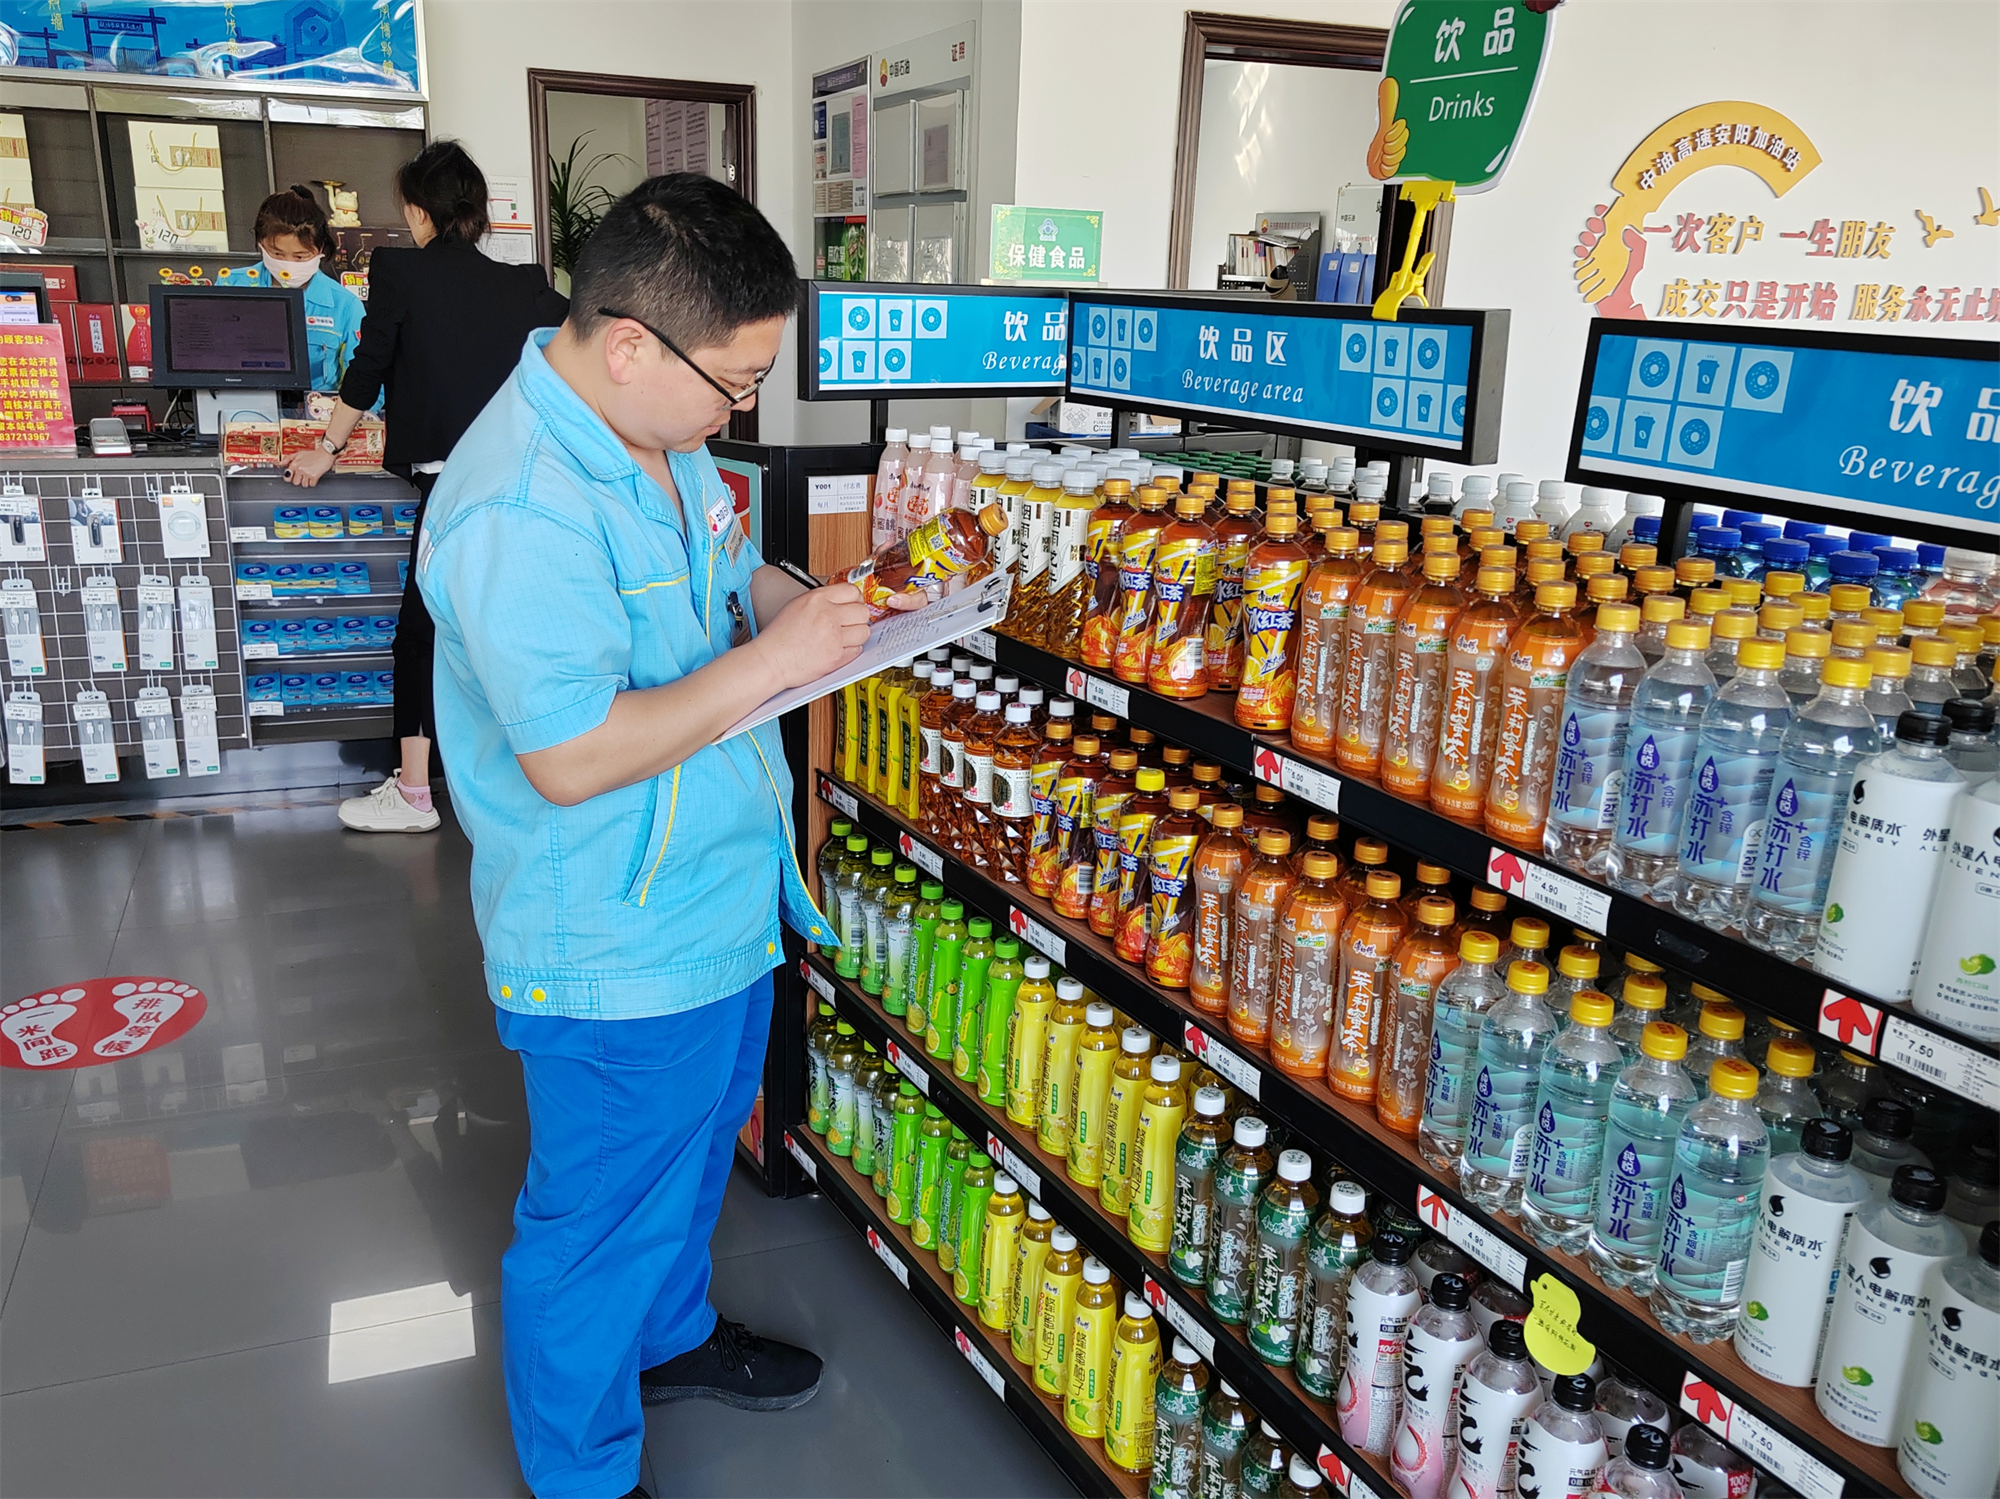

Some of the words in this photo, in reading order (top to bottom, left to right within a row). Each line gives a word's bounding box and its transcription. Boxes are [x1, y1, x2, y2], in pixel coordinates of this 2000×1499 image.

[1435, 7, 1516, 64] 饮品
[889, 58, 911, 78] 中国石油
[1428, 91, 1495, 122] Drinks
[1639, 123, 1802, 191] 中油高速安阳加油站
[11, 225, 32, 240] 120
[1644, 212, 1765, 255] 一次客户
[1780, 217, 1896, 259] 一生朋友
[1008, 242, 1086, 270] 保健食品
[1657, 278, 1838, 321] 成交只是开始
[0, 335, 49, 345] 顾客您好：
[1003, 310, 1066, 342] 饮品
[1199, 325, 1288, 367] 饮品区
[0, 367, 58, 378] 发票后会推送
[1181, 368, 1260, 404] Beverage
[1262, 383, 1305, 404] area
[1247, 606, 1296, 633] 冰红茶
[1640, 743, 1656, 768] 纯悦
[1553, 746, 1578, 813] 苏打水
[1581, 761, 1595, 785] 含锌
[1701, 763, 1716, 788] 纯悦
[1626, 770, 1657, 839] 苏打水
[1660, 785, 1676, 809] 含锌
[1778, 788, 1795, 815] 纯悦
[1686, 793, 1715, 866] 苏打水
[1717, 811, 1736, 834] 含锌
[1759, 816, 1794, 893] 苏打水
[1795, 835, 1814, 861] 含锌
[1541, 881, 1559, 896] 4.90
[15, 1010, 72, 1062] 一米间距
[100, 997, 165, 1054] 排队等候
[1908, 1039, 1934, 1058] 7.50
[1468, 1095, 1490, 1159] 苏打水
[1491, 1113, 1504, 1140] 含烟酸
[1530, 1131, 1553, 1197] 苏打水
[1555, 1150, 1567, 1178] 含烟酸
[1620, 1149, 1636, 1175] 纯悦
[1608, 1174, 1638, 1242] 苏打水
[1641, 1192, 1656, 1220] 含烟酸
[1467, 1231, 1484, 1248] 4.90
[1660, 1206, 1684, 1277] 苏打水
[1685, 1230, 1700, 1258] 含烟酸
[1750, 1429, 1773, 1452] 7.50
[1729, 1474, 1750, 1487] 100%
